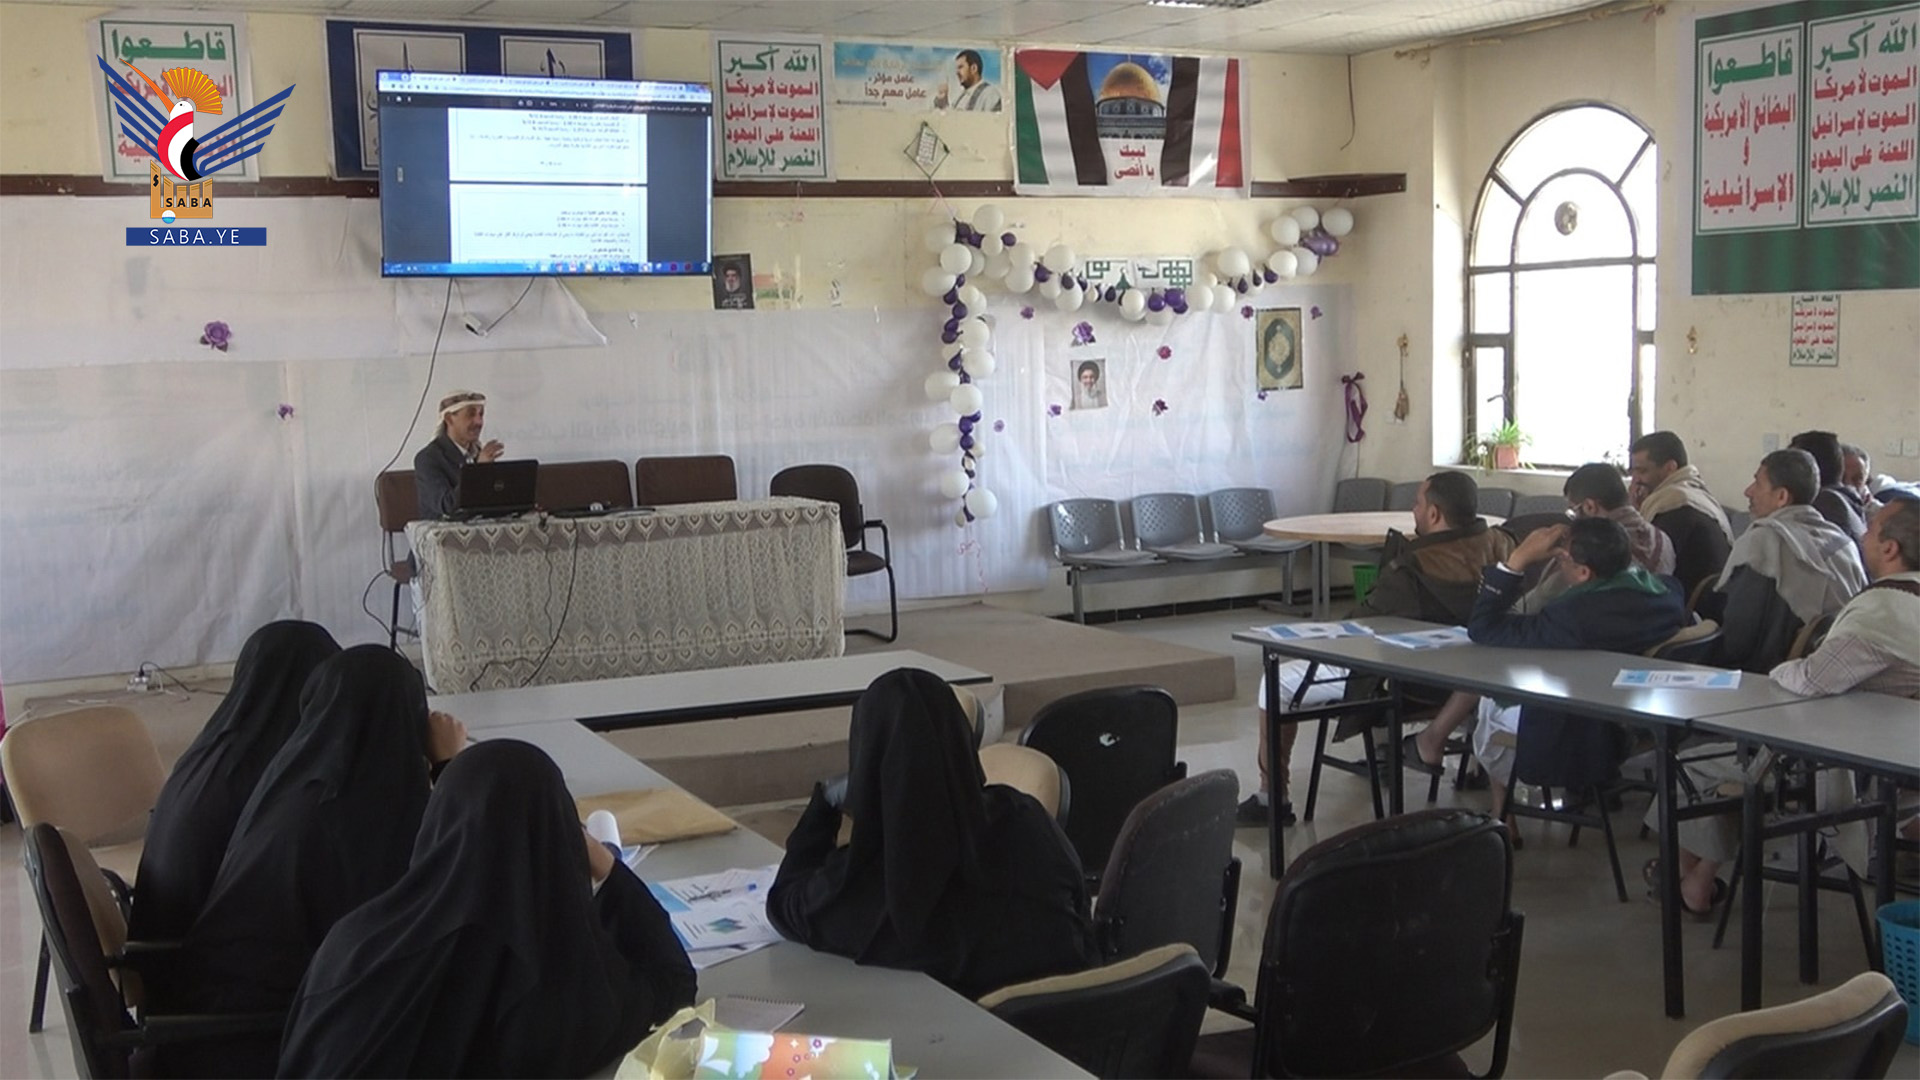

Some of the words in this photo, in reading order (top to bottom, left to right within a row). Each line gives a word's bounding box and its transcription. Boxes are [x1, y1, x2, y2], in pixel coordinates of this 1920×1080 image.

[112, 29, 227, 65] قاطعوا
[1814, 20, 1875, 73] أكبر
[1879, 18, 1917, 54] الله
[724, 45, 780, 77] أكبر
[784, 49, 816, 72] الله
[1708, 37, 1793, 95] قاطعوا
[725, 77, 775, 98] لأمريكا
[776, 80, 819, 98] الموت
[894, 75, 914, 84] عامل
[1814, 68, 1867, 102] لأمريكا
[1868, 66, 1917, 96] الموت
[881, 89, 904, 99] مهم
[905, 88, 927, 99] عامل
[725, 101, 775, 122] لإسرائيل
[778, 104, 820, 121] الموت
[1704, 93, 1750, 138] الأمريكية
[1754, 93, 1796, 133] البضائع
[1812, 107, 1866, 139] لإسرائيل
[1868, 102, 1916, 131] الموت
[726, 126, 762, 144] اليهود
[764, 127, 784, 144] على
[790, 126, 820, 142] اللعنة
[728, 147, 775, 173] للإسلام
[779, 148, 821, 171] النصر
[1119, 144, 1146, 161] لبيك
[1811, 145, 1848, 174] اليهود
[1850, 144, 1873, 171] على
[1878, 138, 1914, 163] اللعنة
[1114, 157, 1144, 180] أقصى
[1146, 164, 1155, 180] يا
[1703, 172, 1794, 214] الإسرائيلية
[1811, 174, 1861, 215] للإسلام
[1864, 172, 1913, 211] النصر
